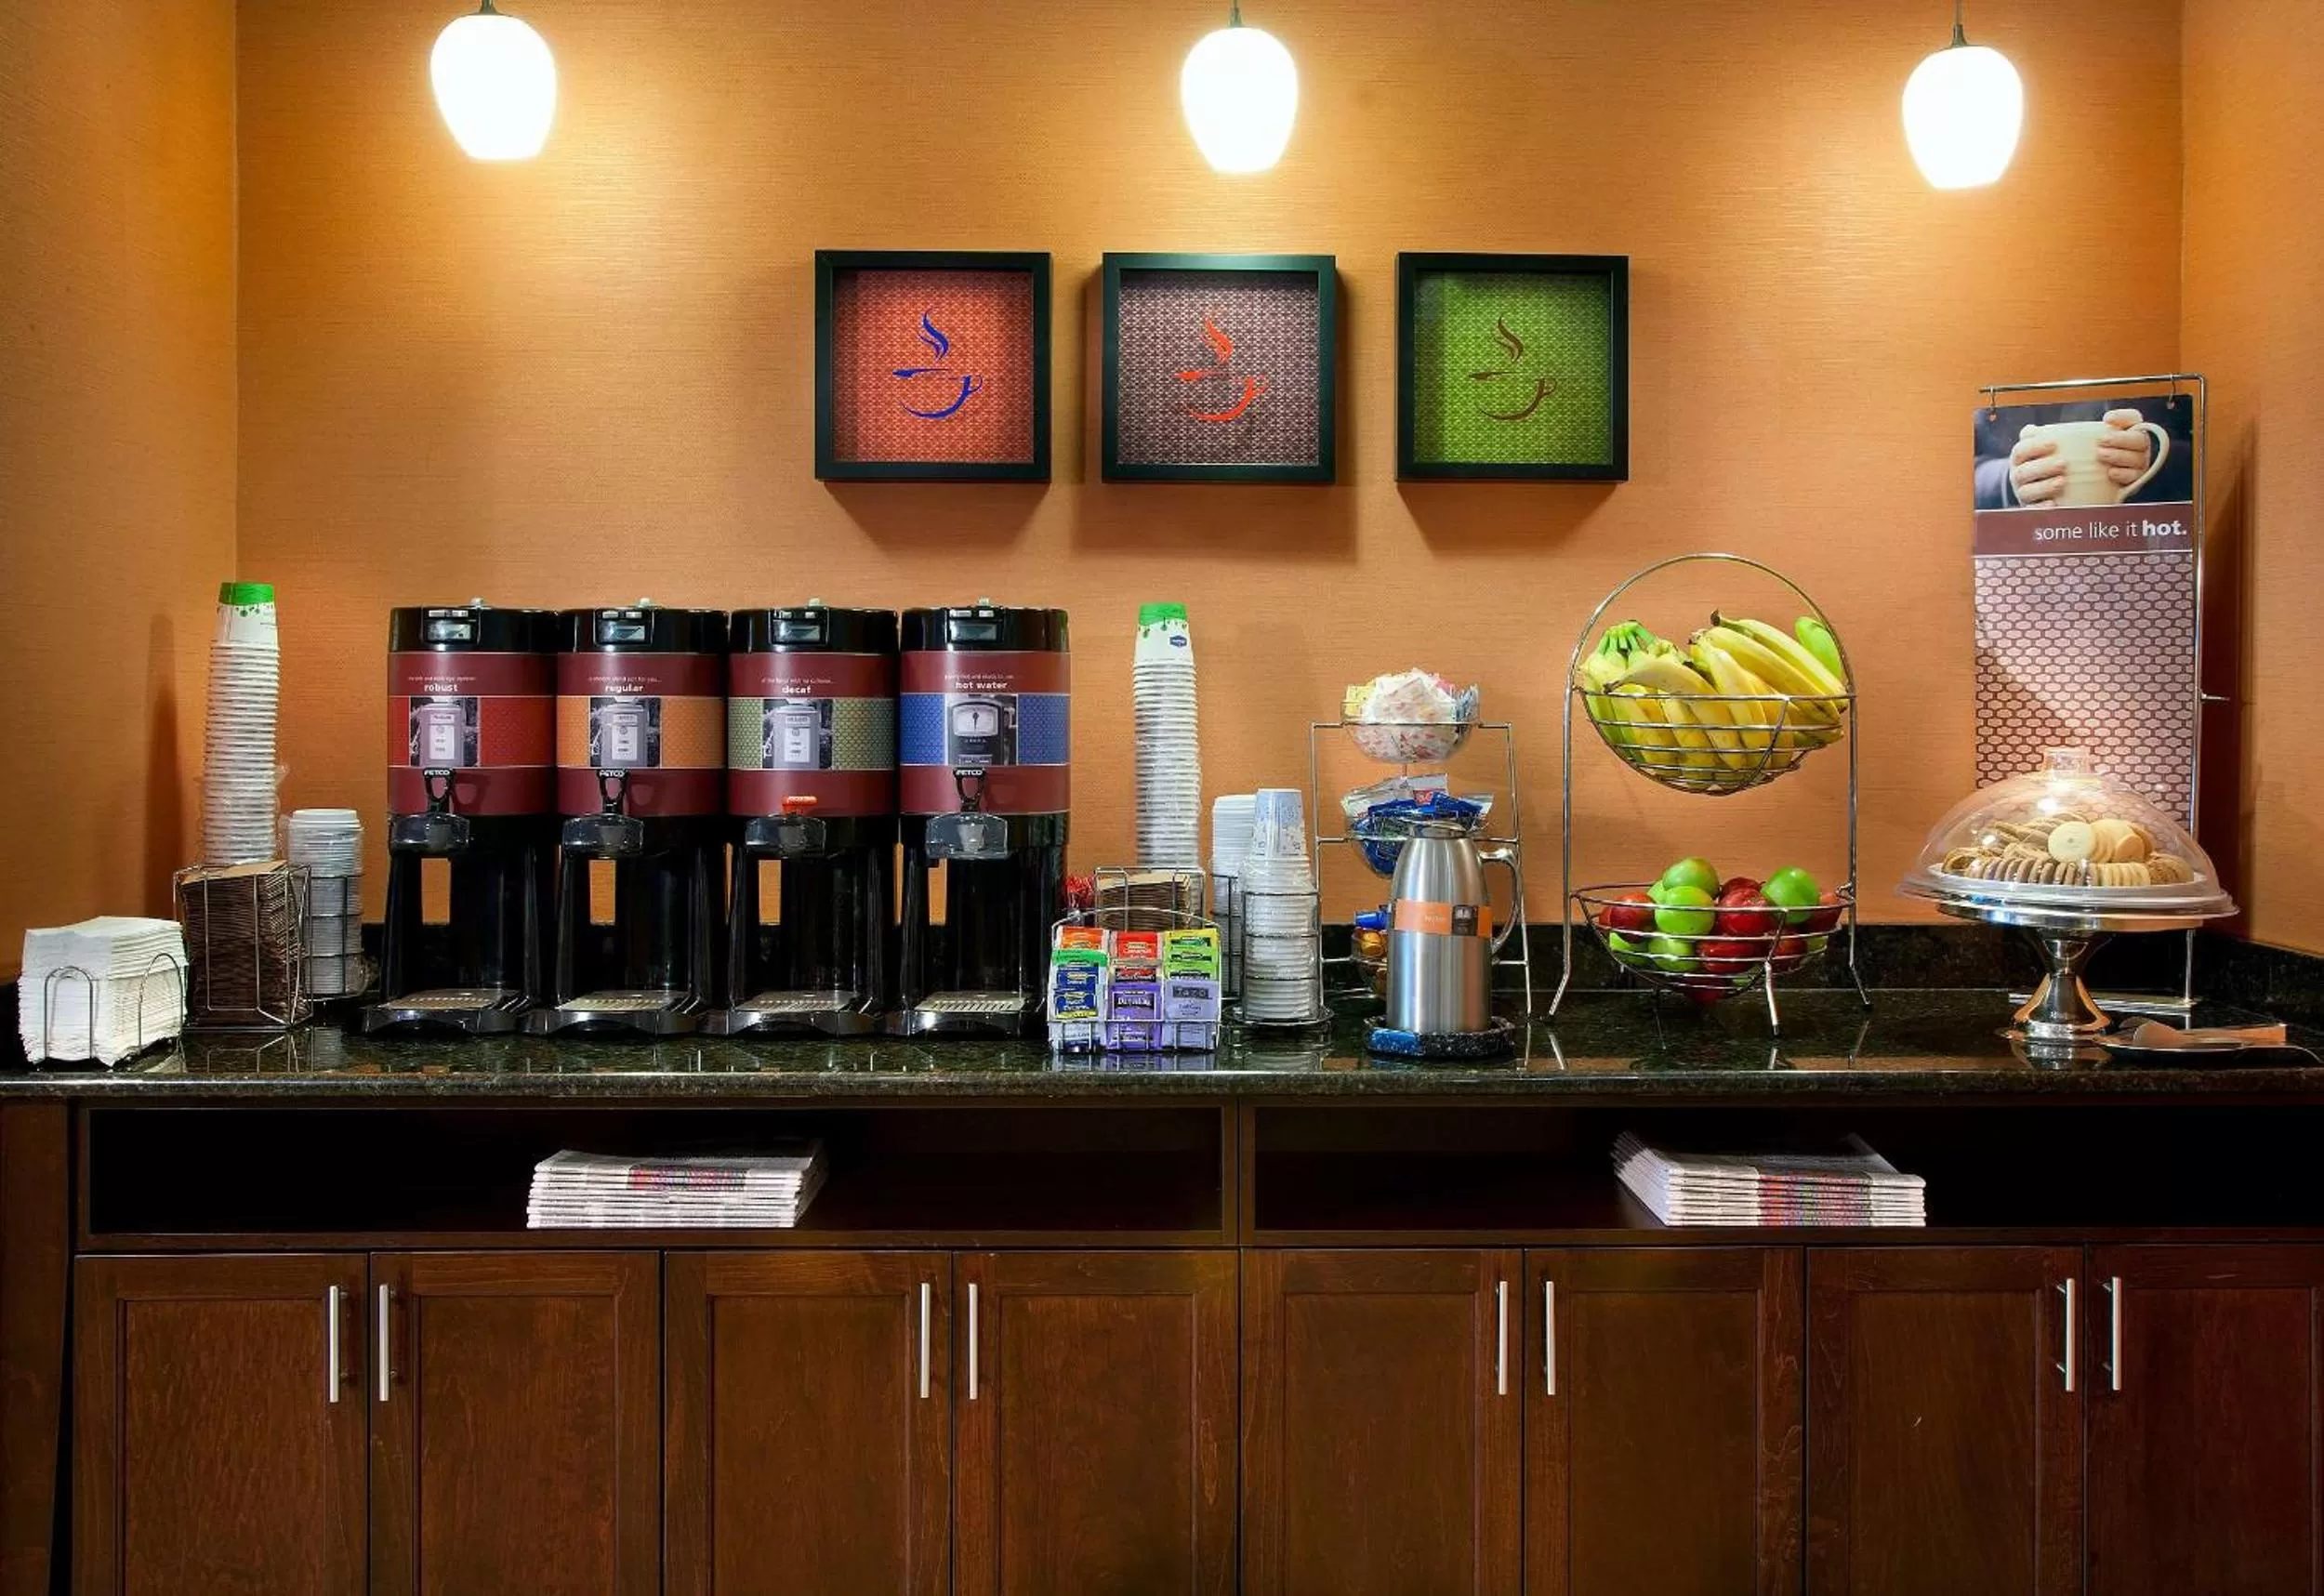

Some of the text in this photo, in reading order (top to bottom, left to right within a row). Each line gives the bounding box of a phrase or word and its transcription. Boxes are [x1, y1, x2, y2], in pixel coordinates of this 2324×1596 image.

[2035, 519, 2187, 540] some like it hot.
[424, 682, 458, 692] robust
[605, 683, 643, 693] regular
[781, 685, 812, 693] decaf
